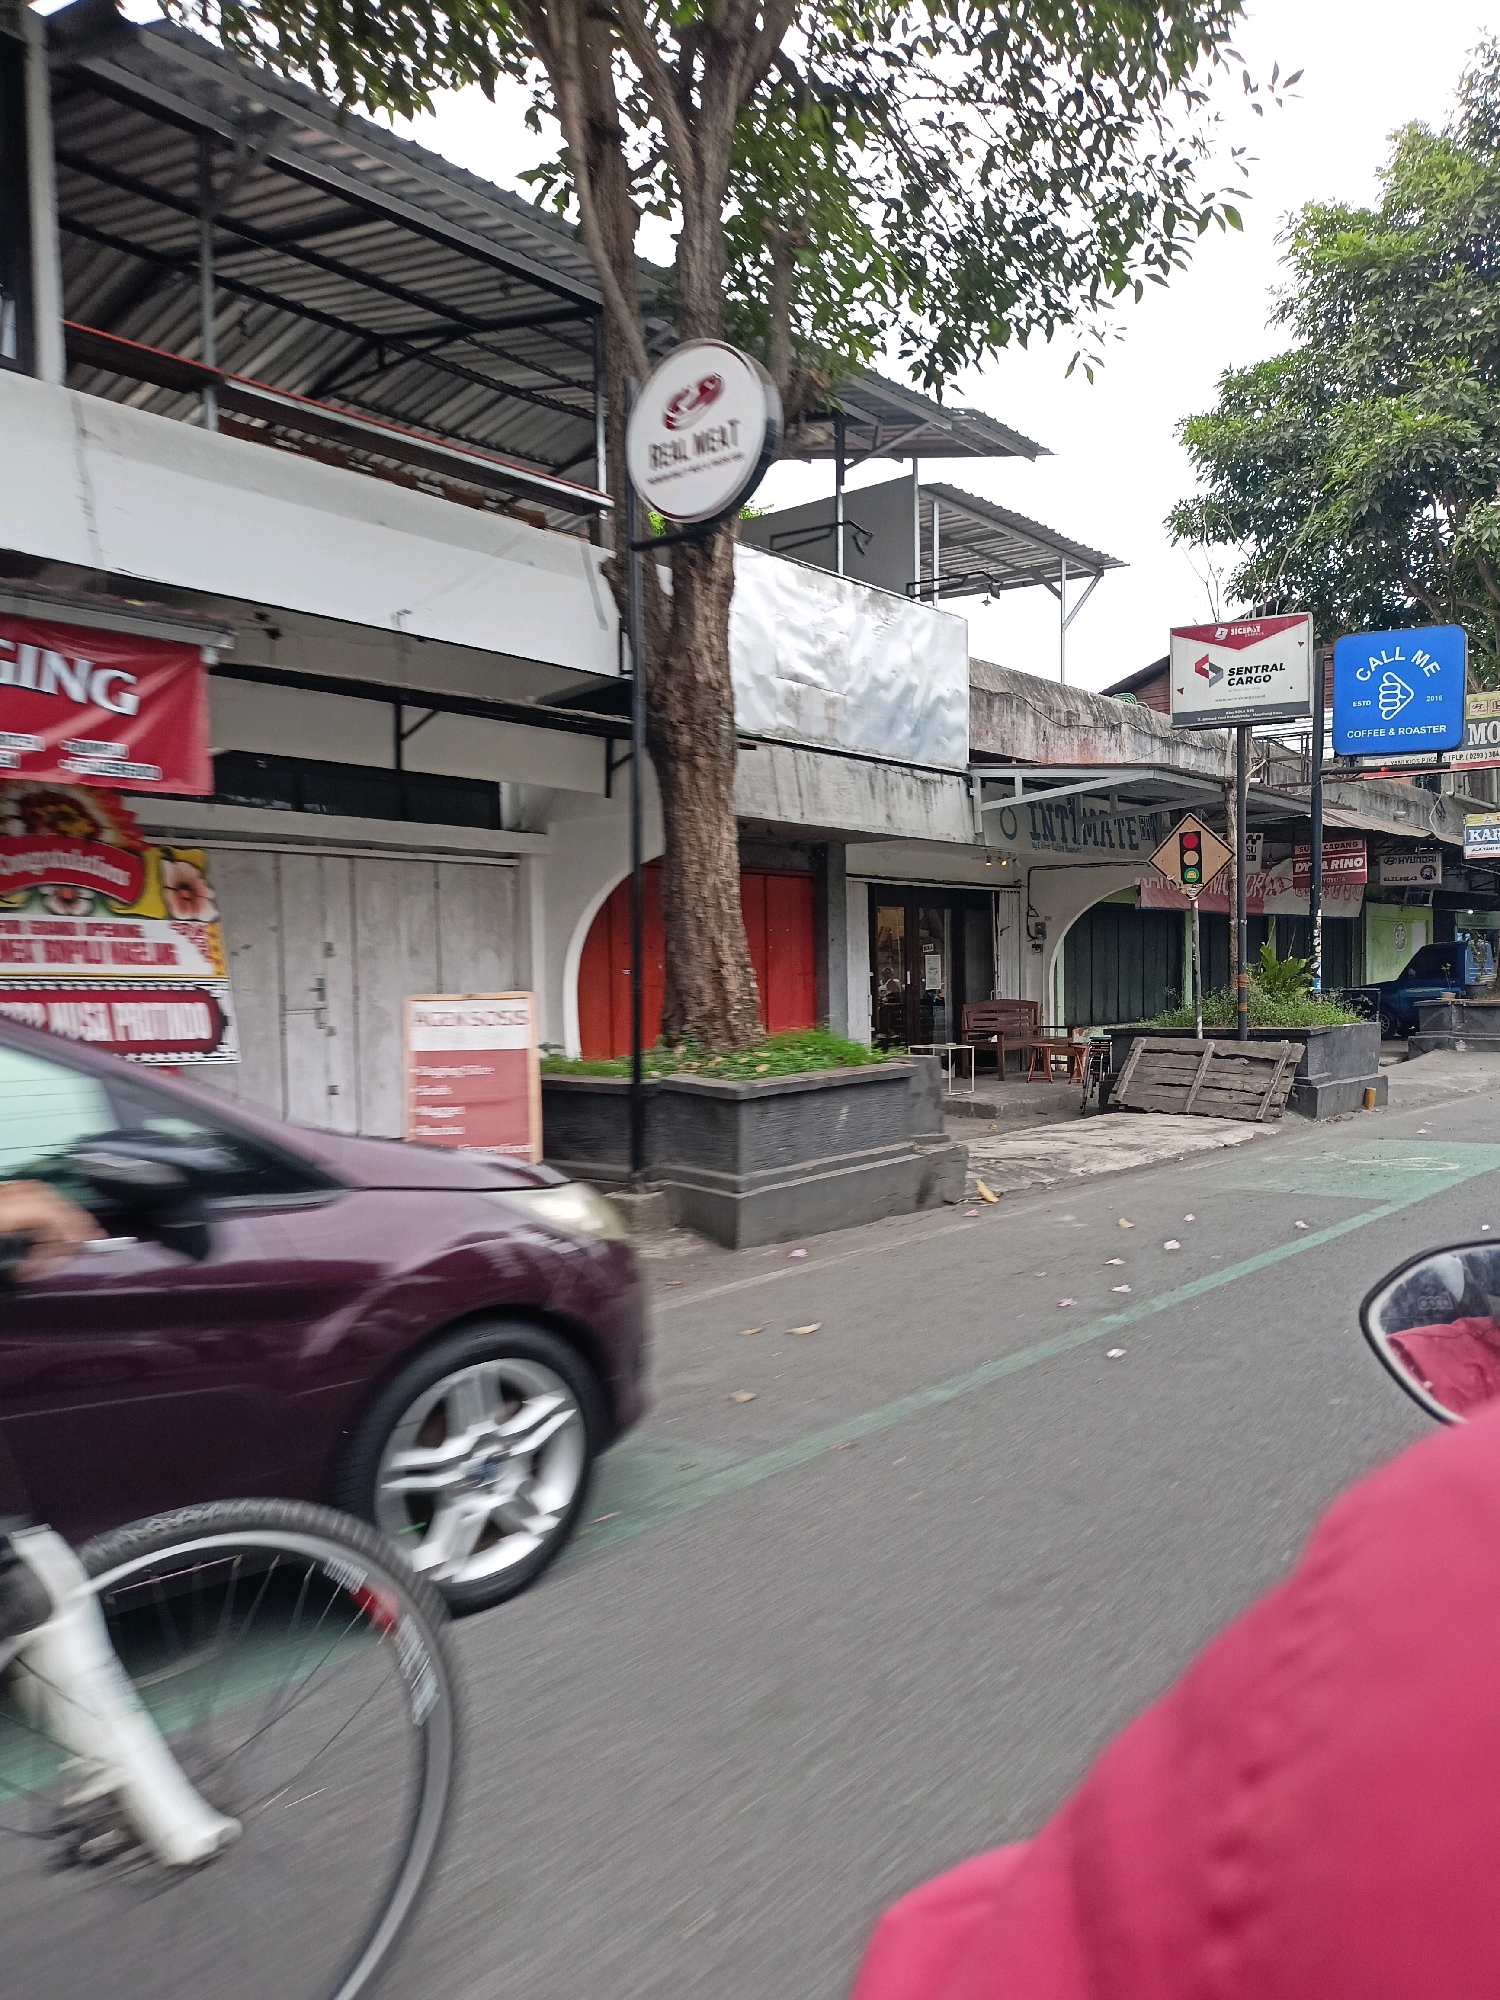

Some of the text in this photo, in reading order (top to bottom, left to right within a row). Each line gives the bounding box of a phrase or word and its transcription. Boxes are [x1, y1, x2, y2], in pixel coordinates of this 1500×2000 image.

[692, 418, 741, 457] MEAT
[1228, 663, 1286, 676] SENTRAL
[1356, 647, 1441, 681] CALL ME
[1228, 675, 1271, 686] CARGO
[1347, 728, 1386, 738] COFFEE
[1398, 725, 1447, 735] ROASTER
[1028, 800, 1139, 850] INTIMATE
[1323, 841, 1359, 850] CADANG
[1295, 857, 1363, 873] DYA RINO
